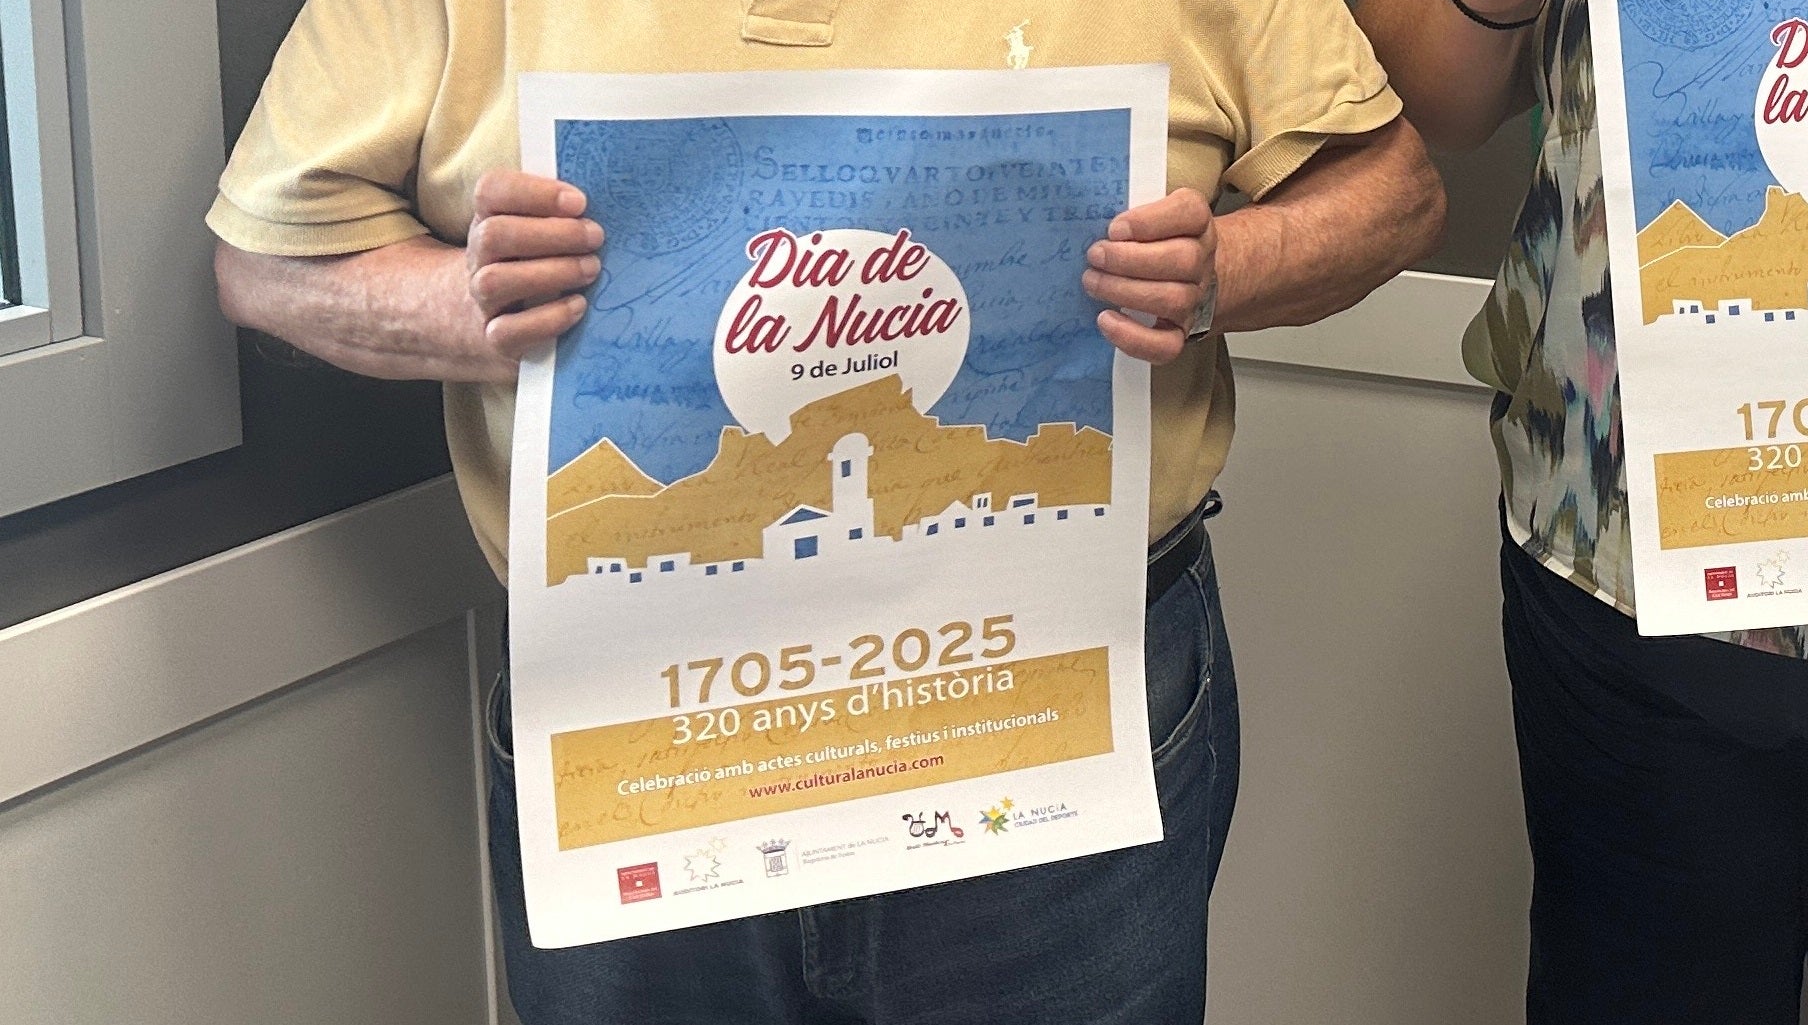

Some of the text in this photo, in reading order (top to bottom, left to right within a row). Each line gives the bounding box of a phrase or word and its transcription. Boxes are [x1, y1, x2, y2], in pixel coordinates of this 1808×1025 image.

[749, 230, 930, 288] Dia de
[725, 288, 962, 354] la Nucia
[791, 350, 898, 381] 9 de Juliol
[1747, 444, 1801, 472] 320
[1705, 492, 1779, 509] Celebració
[661, 614, 1017, 709] 1705-2025
[672, 708, 741, 746] 320
[753, 698, 836, 734] anys
[617, 767, 711, 797] Celebració
[714, 760, 754, 781] amb
[757, 754, 802, 775] actes
[805, 740, 883, 766] culturals,
[885, 729, 941, 751] festius
[951, 707, 1060, 739] institucionals
[749, 753, 945, 799] www.culturalanucia.com
